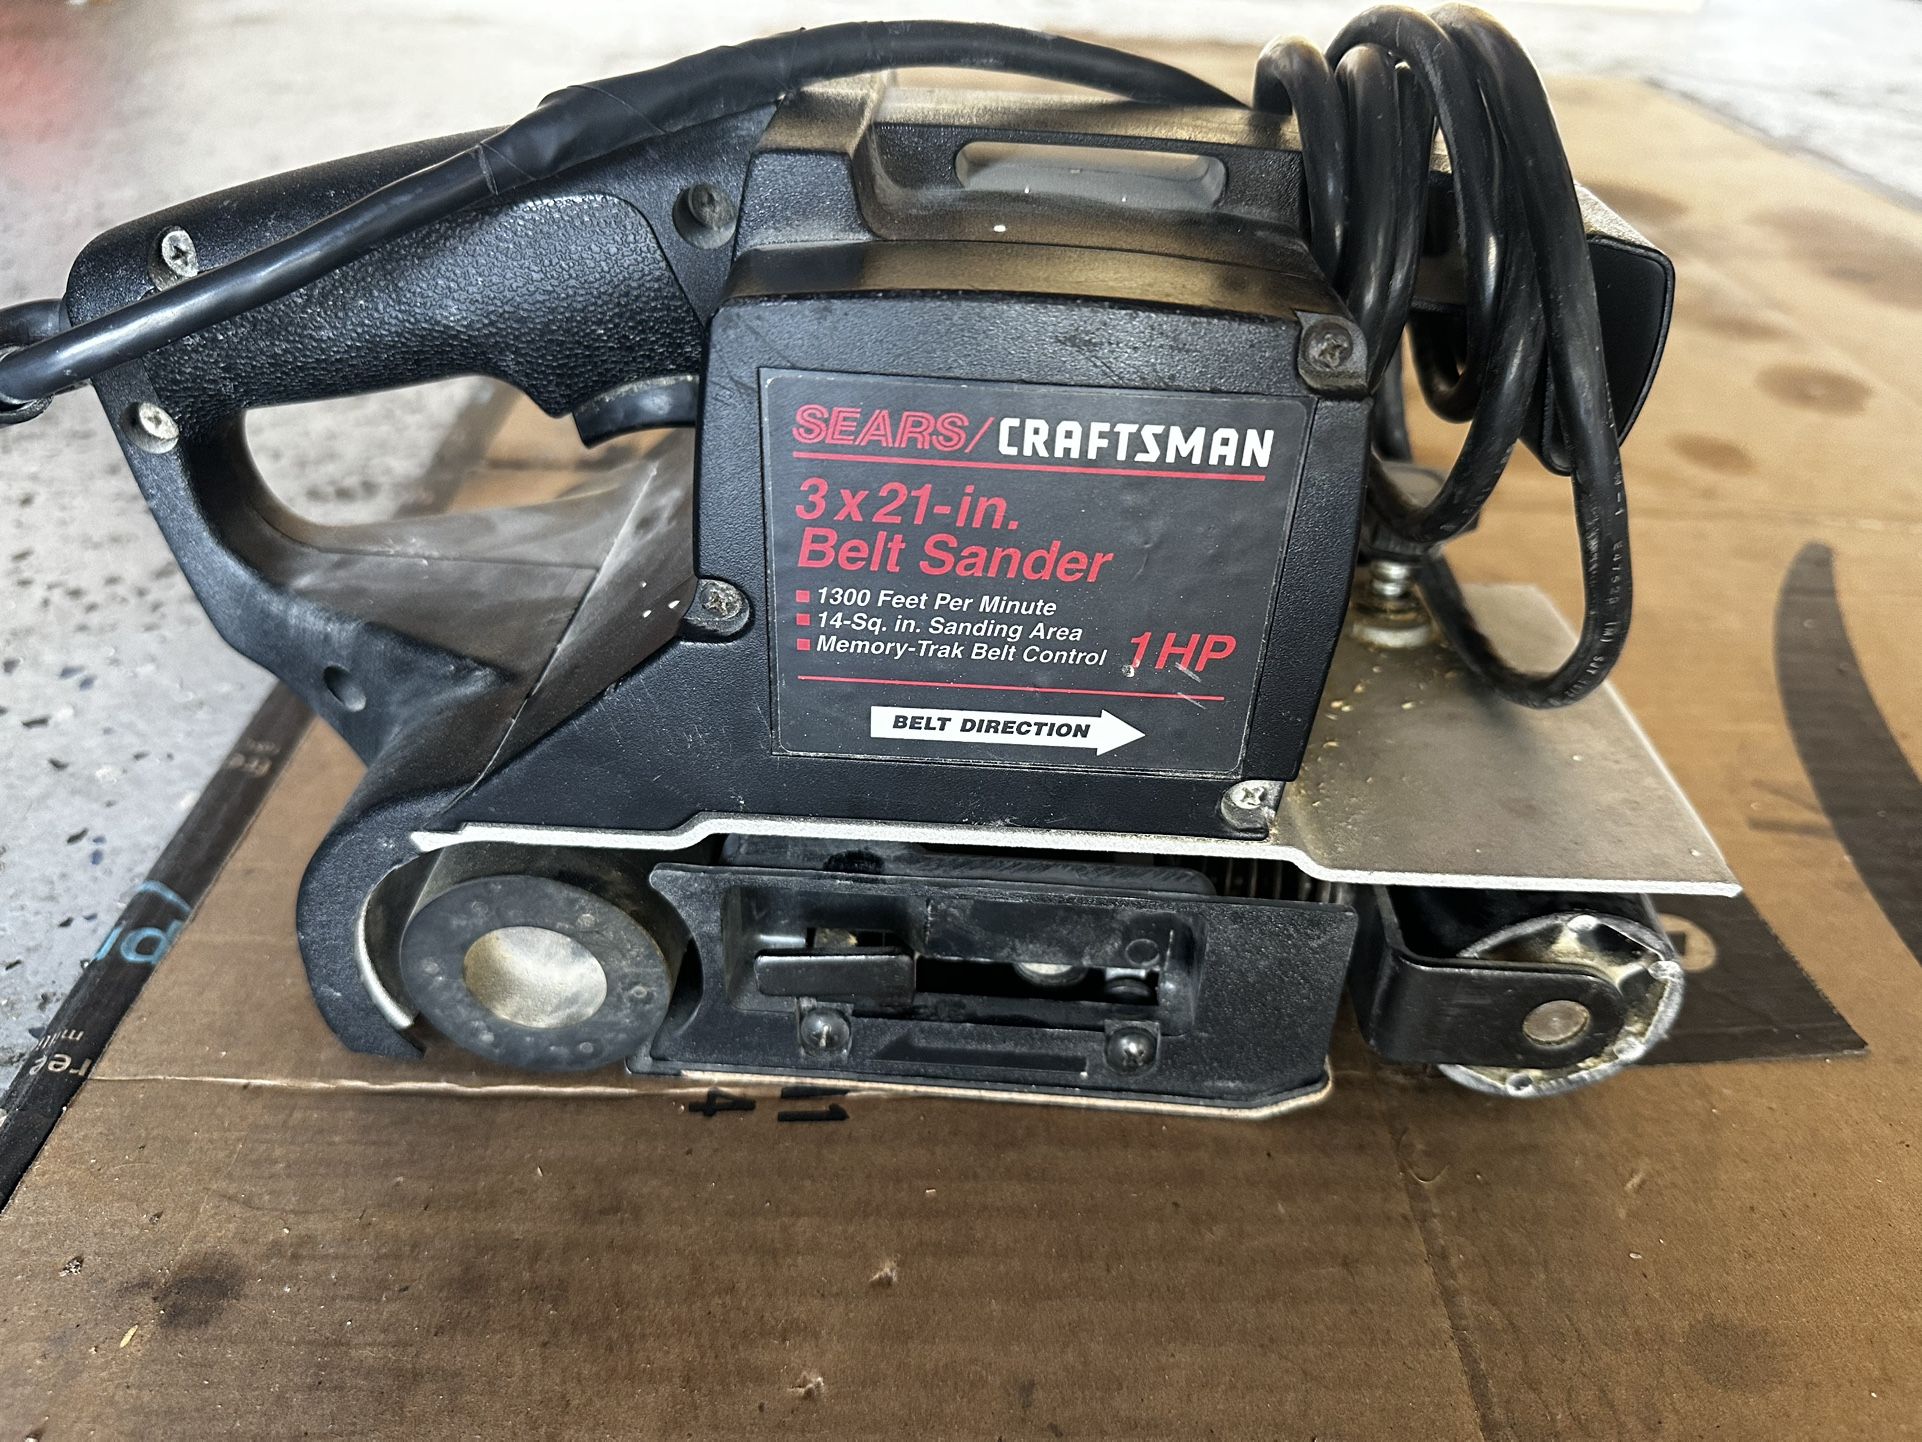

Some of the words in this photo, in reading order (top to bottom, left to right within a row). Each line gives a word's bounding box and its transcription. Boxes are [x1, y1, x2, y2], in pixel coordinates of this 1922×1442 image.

[998, 417, 1275, 468] CRAFTSMAN
[797, 527, 906, 573] Belt
[919, 533, 1114, 583] Sander
[817, 586, 871, 607] 1300
[877, 589, 928, 610] Feet
[934, 592, 973, 612] Per
[978, 595, 1057, 616] Minute
[818, 611, 887, 635] 14-Sq.
[894, 615, 921, 633] in.
[928, 616, 1023, 642] Sanding
[1028, 622, 1083, 641] Area
[816, 634, 965, 660] Memory-Trak
[970, 642, 1017, 662] Belt
[1022, 645, 1108, 666] Control
[892, 714, 952, 731] BELT
[959, 718, 1091, 738] DIRECTION
